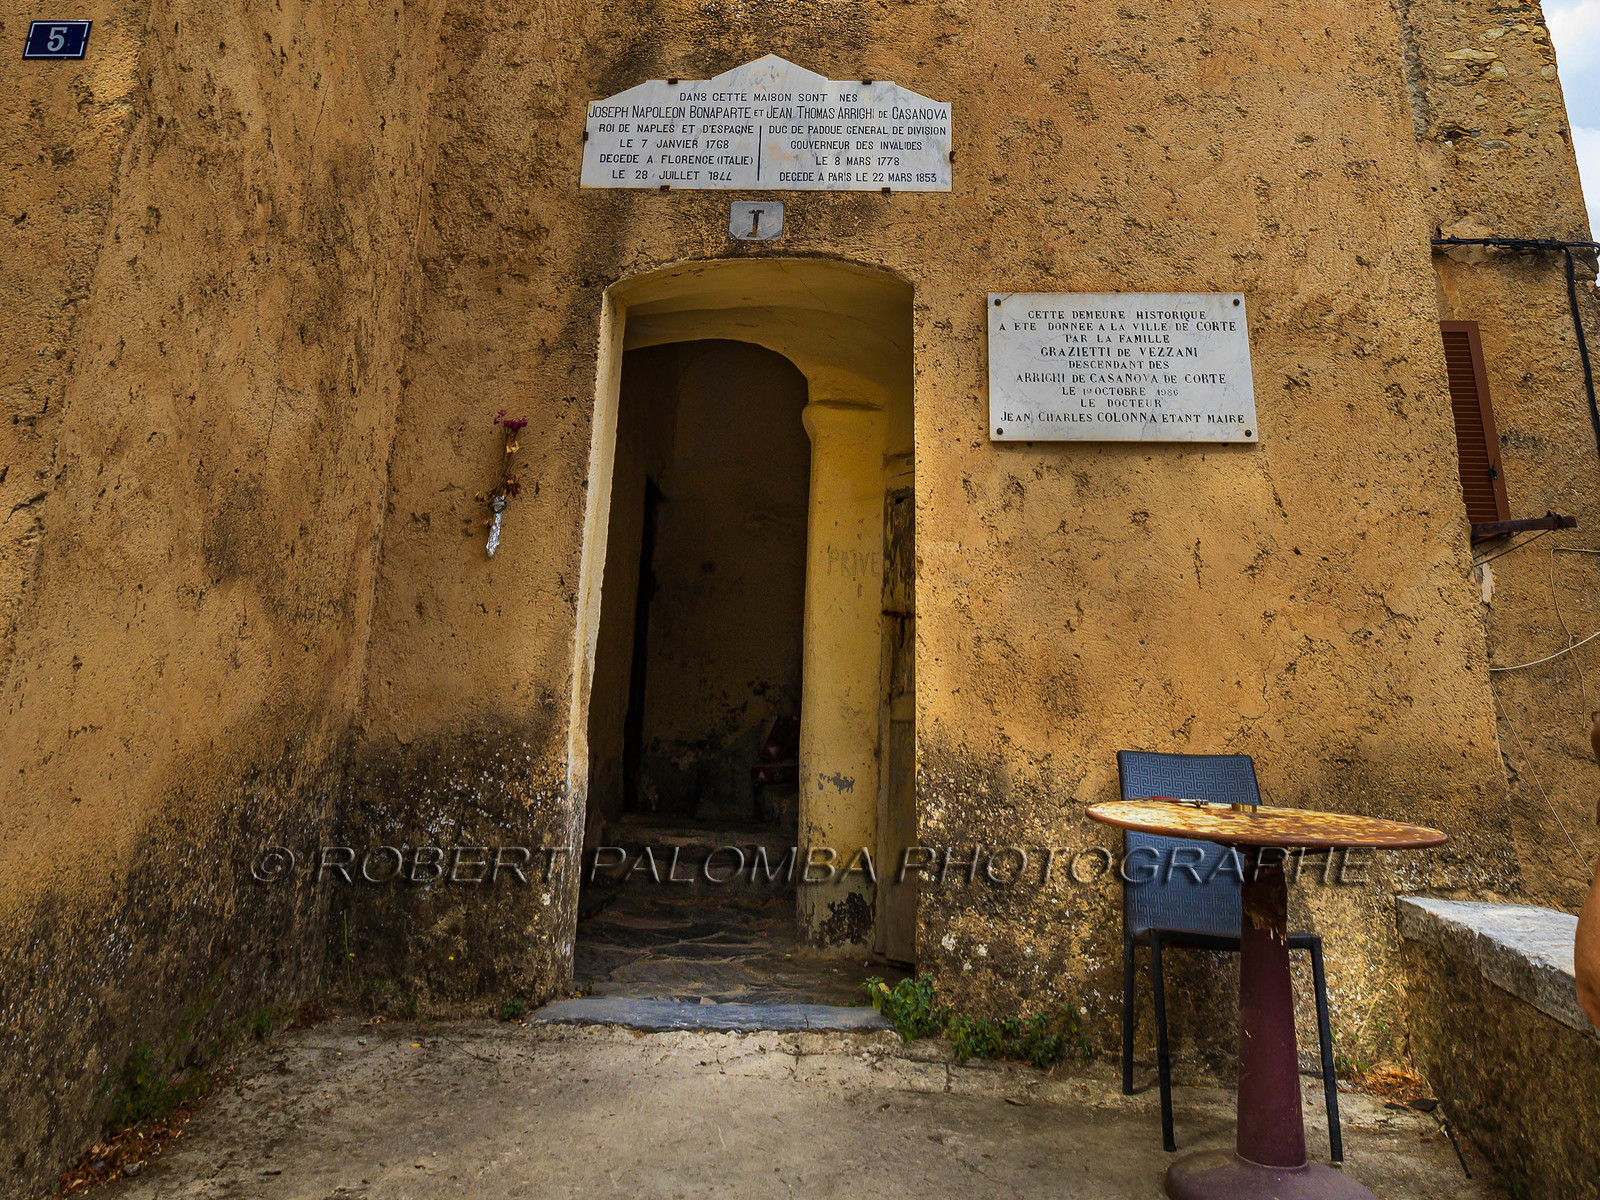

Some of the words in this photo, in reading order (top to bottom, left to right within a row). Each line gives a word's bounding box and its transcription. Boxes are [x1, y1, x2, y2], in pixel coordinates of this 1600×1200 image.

[47, 26, 68, 52] 5
[679, 92, 707, 102] DANS
[712, 92, 748, 102] CETTE
[754, 93, 792, 102] MAISON
[798, 94, 828, 102] SONT
[839, 94, 858, 103] NES
[588, 105, 629, 118] JOSEPH
[632, 105, 686, 119] NAPOLEON
[689, 105, 752, 119] BONAPARTE
[766, 106, 793, 119] JEAN
[796, 105, 835, 119] THOMAS
[838, 106, 875, 120] ARRIGHI
[878, 110, 889, 119] DE
[892, 106, 948, 120] CASANOVA
[598, 123, 615, 133] ROI
[618, 124, 630, 133] DE
[636, 124, 675, 133] NAPLES
[682, 124, 696, 134] ET
[702, 124, 754, 134] D'ESPAGNE
[768, 125, 788, 134] DUC
[791, 126, 804, 134] DE
[807, 126, 843, 135] PADOUE
[846, 126, 889, 135] GENERAL
[892, 126, 904, 135] DE
[908, 126, 946, 136] DIVISION
[620, 138, 634, 148] LE
[642, 139, 648, 148] 7
[656, 139, 699, 149] JANVIER
[706, 140, 729, 149] 1768
[790, 140, 850, 150] GOUVERNEUR
[856, 141, 874, 150] DES
[880, 141, 923, 151] INVALIDES
[600, 154, 640, 164] DECEDE
[646, 155, 654, 164] A
[661, 154, 715, 165] FLORENCE
[716, 155, 754, 166] (ITALIE)
[816, 156, 828, 166] LE
[834, 156, 841, 166] 8
[846, 156, 871, 166] MARS
[878, 156, 900, 166] 1778
[612, 170, 626, 179] LE
[635, 170, 648, 180] 28
[658, 170, 700, 180] JUILLET
[708, 171, 732, 181] 1844
[779, 172, 815, 182] DECEDE
[818, 172, 825, 182] A
[828, 172, 852, 182] PARIS
[856, 172, 868, 182] LE
[872, 172, 884, 182] 22
[888, 173, 913, 182] MARS
[916, 173, 937, 183] 1853
[1028, 310, 1065, 320] CETTE
[1072, 310, 1126, 320] DEMEURE
[1136, 310, 1207, 321] HISTORIQUE
[999, 323, 1006, 331] A
[1014, 322, 1037, 331] ETE
[1048, 322, 1094, 331] DONNEE
[1098, 323, 1105, 332] A
[1110, 322, 1126, 332] LA
[1132, 322, 1168, 332] VILLE
[1175, 322, 1189, 332] DE
[1196, 322, 1237, 332] CORTE
[1065, 334, 1088, 343] PAR
[1097, 334, 1112, 343] LA
[1119, 334, 1170, 344] FAMILLE
[1040, 346, 1111, 357] GRAZIETTI
[1117, 348, 1131, 358] DE
[1140, 347, 1198, 358] VEZZANI
[1068, 360, 1145, 370] DESCENDANT
[1149, 360, 1170, 370] DES
[1016, 372, 1065, 383] ARRIGHI
[1072, 374, 1086, 384] DE
[1089, 373, 1159, 384] CASANOVA
[1163, 374, 1178, 384] DE
[1184, 374, 1227, 384] CORTE
[1062, 386, 1076, 396] LE
[1094, 386, 1146, 396] OCTOBRE
[1080, 398, 1096, 408] LE
[1107, 399, 1162, 408] DOCTEUR
[1000, 412, 1031, 422] JEAN
[1038, 412, 1093, 423] CHARLES
[1097, 412, 1158, 424] COLONNA
[1162, 414, 1201, 424] ETANT
[1207, 414, 1245, 424] MAIRE
